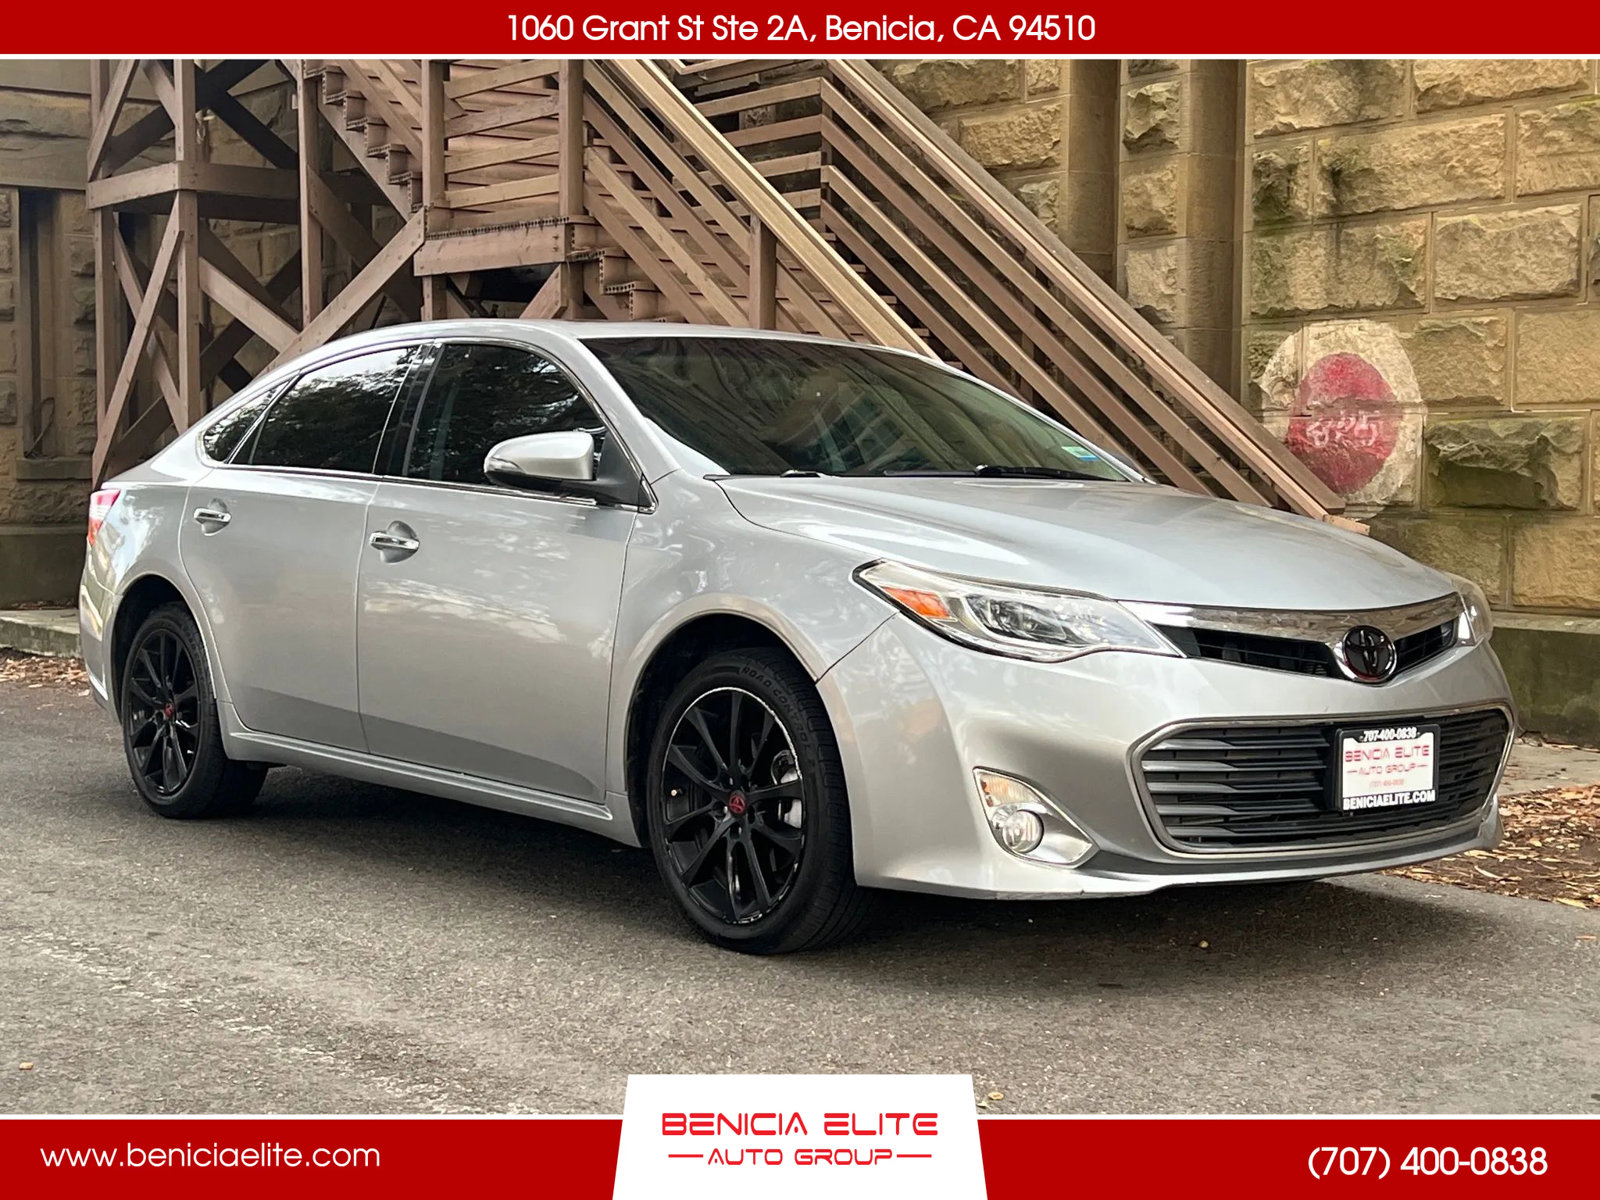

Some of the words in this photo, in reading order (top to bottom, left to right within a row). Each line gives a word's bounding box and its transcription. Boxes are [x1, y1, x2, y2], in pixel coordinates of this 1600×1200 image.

[742, 666, 772, 687] ROAD
[1395, 745, 1430, 759] ELITE
[1359, 766, 1383, 775] AUTO
[1386, 763, 1416, 773] GROUP
[1343, 789, 1435, 811] BENICIAELITE.COM
